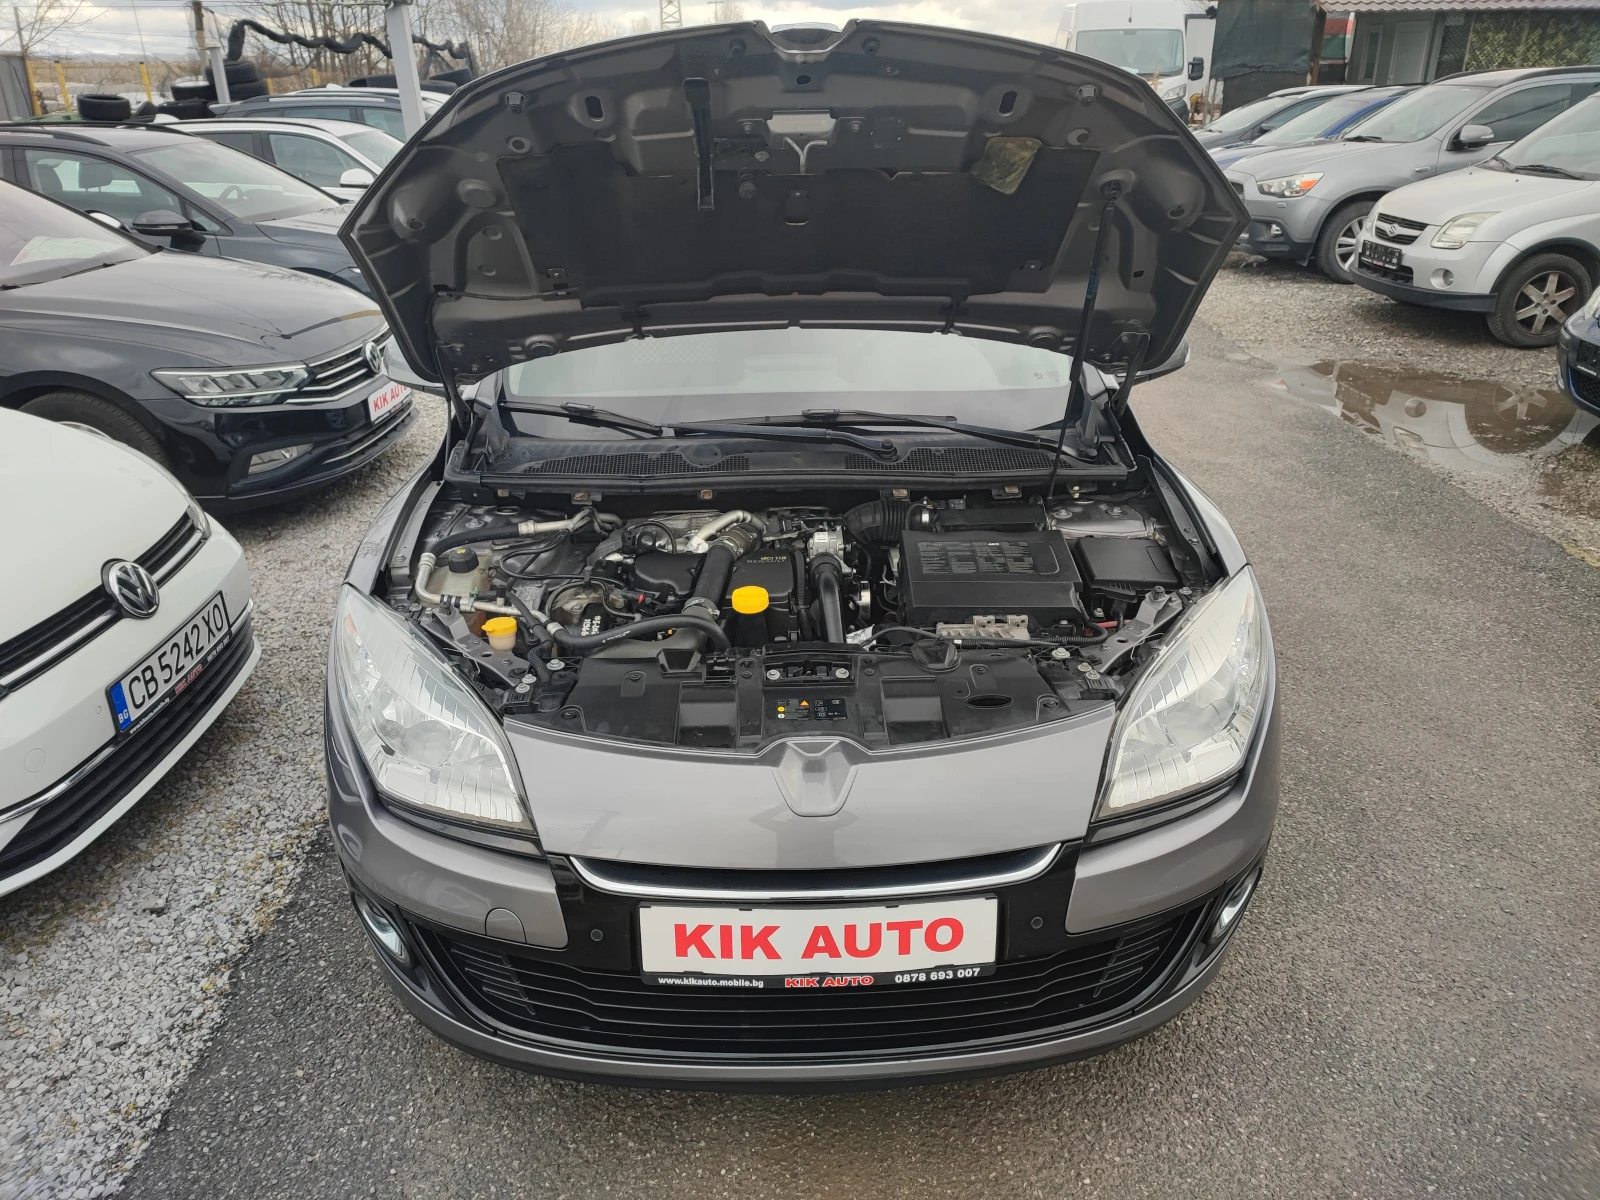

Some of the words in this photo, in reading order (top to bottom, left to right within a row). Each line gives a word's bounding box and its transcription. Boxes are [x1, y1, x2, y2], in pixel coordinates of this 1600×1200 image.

[373, 392, 389, 413] KIK
[128, 664, 159, 710] CB
[157, 623, 205, 684] 5242
[201, 603, 224, 644] XO
[117, 708, 130, 724] BG
[674, 923, 782, 960] KIK
[801, 917, 965, 959] AUTO
[658, 977, 764, 988] www.kikauto.mobile.bg
[784, 977, 819, 988] KIK
[822, 975, 874, 988] AUTO
[894, 973, 927, 984] 0878
[929, 970, 954, 981] 693
[956, 967, 981, 978] 007
